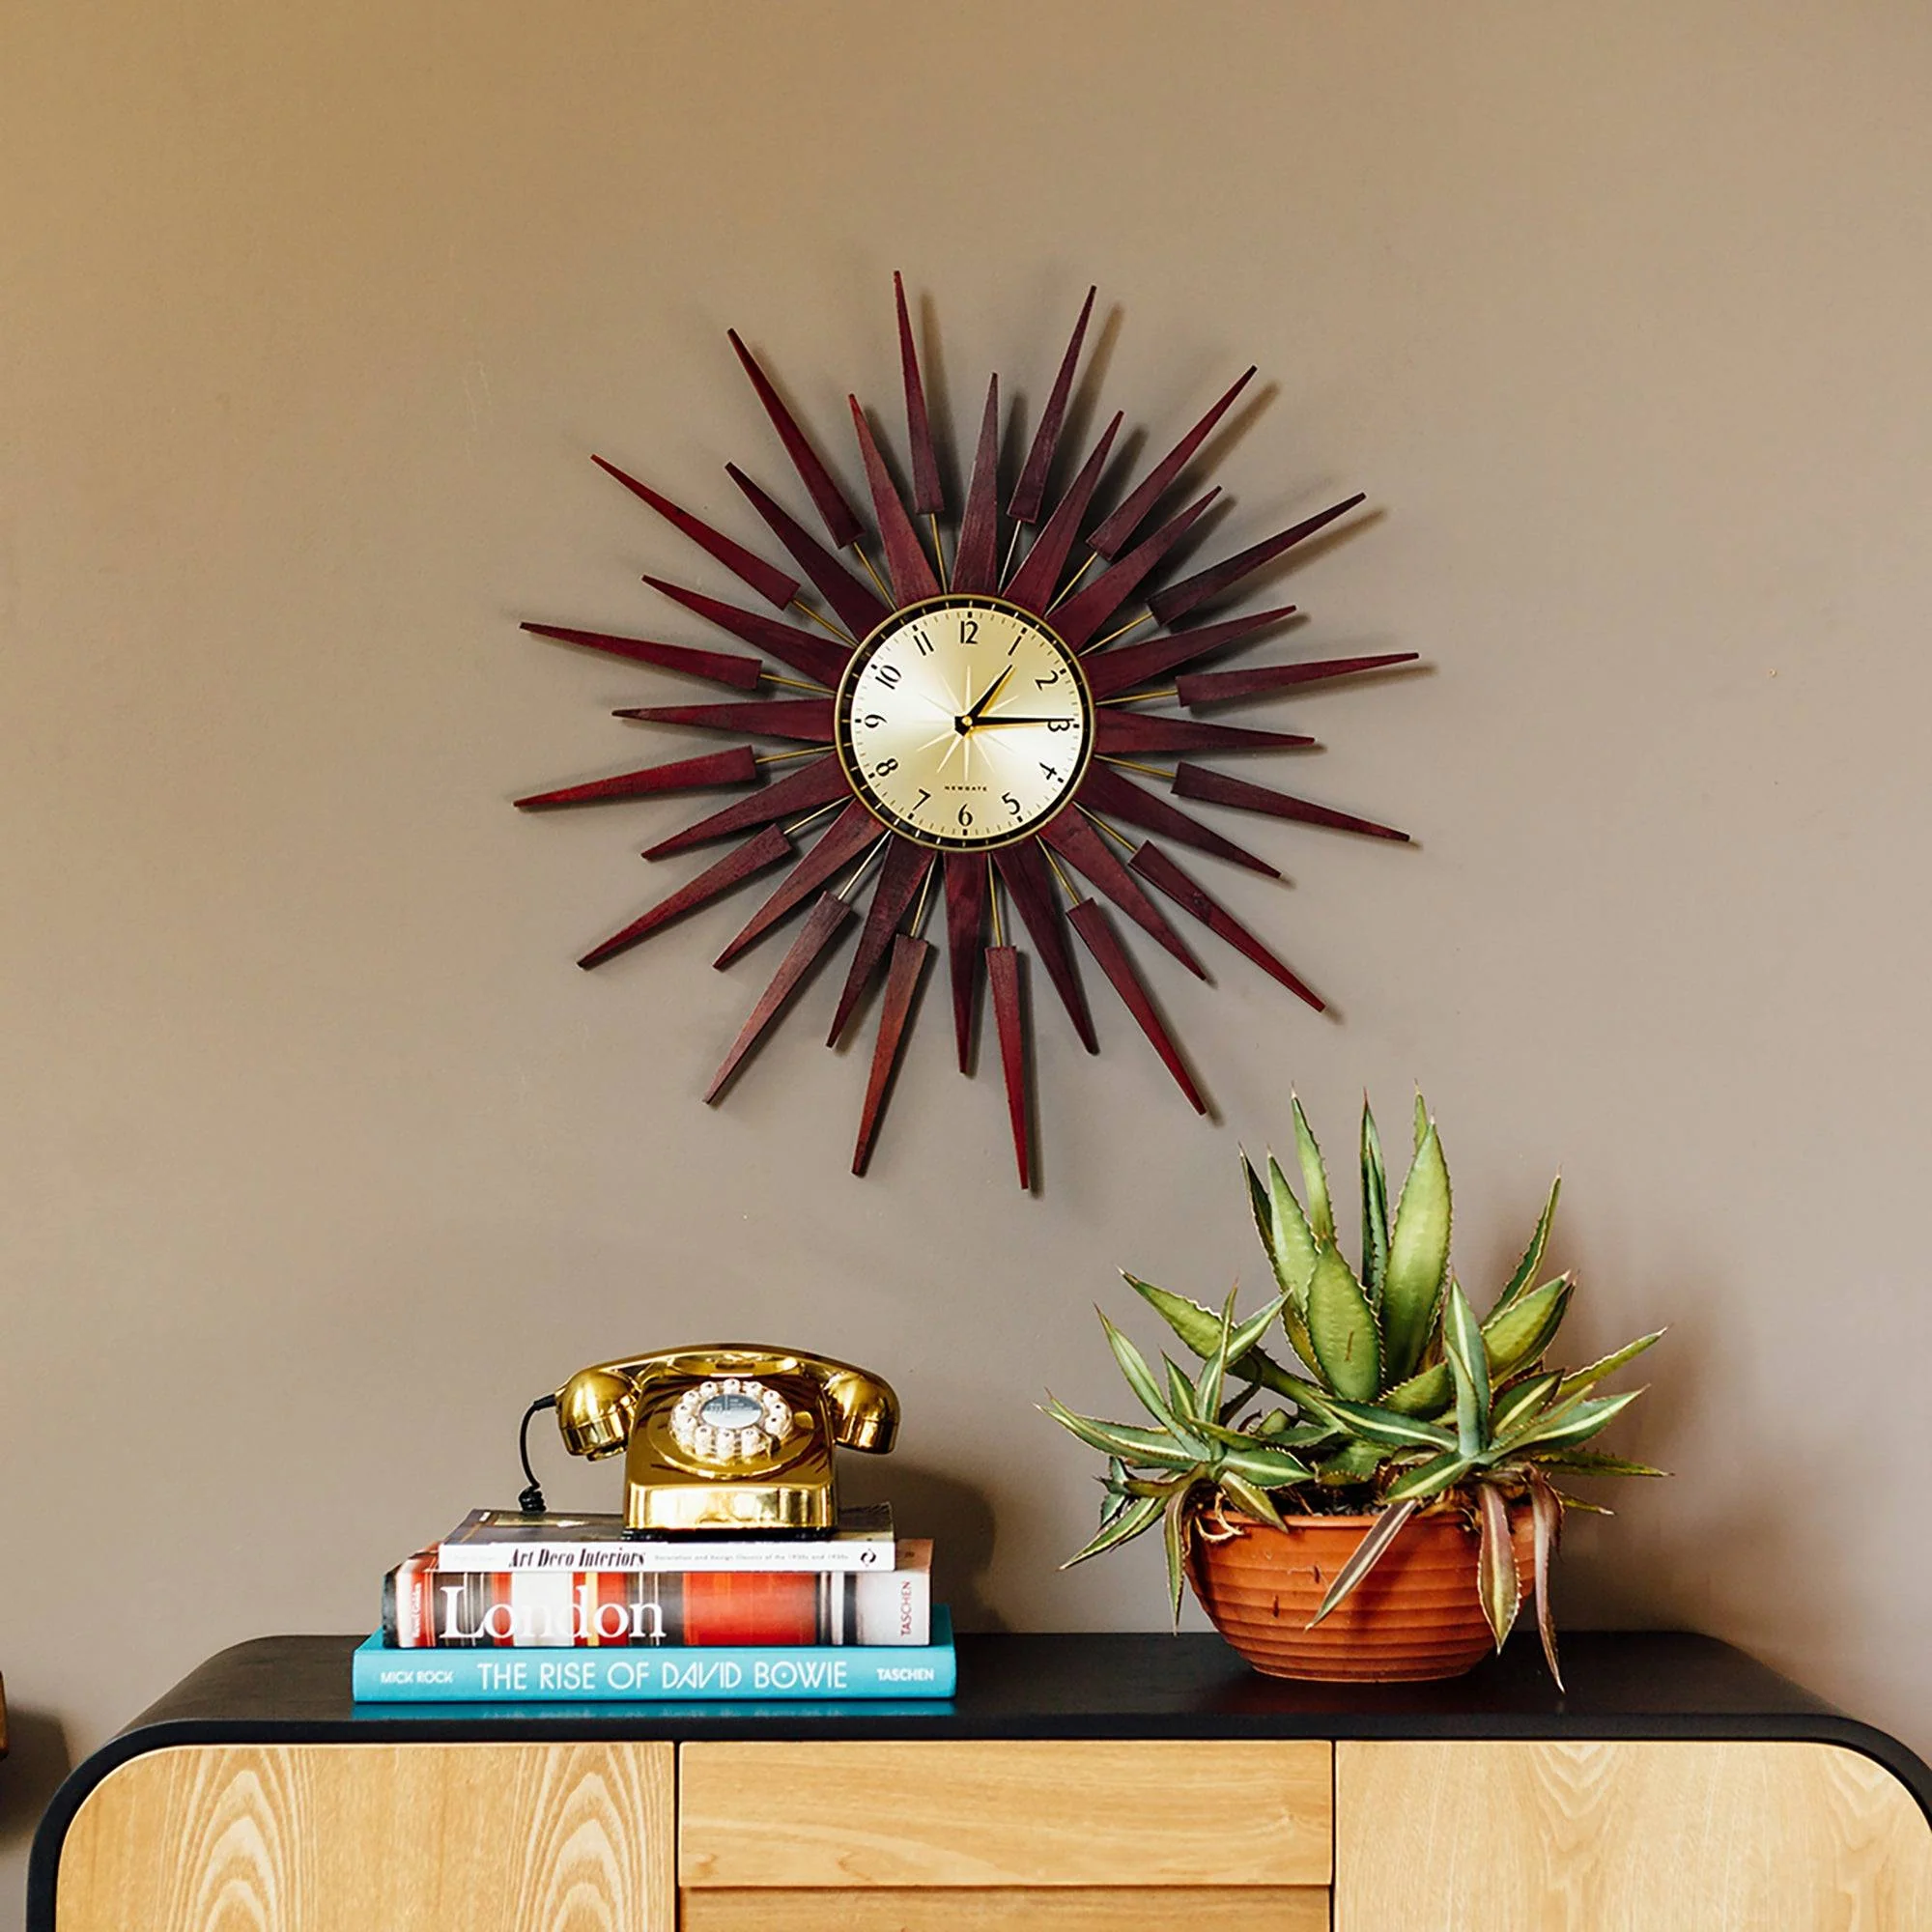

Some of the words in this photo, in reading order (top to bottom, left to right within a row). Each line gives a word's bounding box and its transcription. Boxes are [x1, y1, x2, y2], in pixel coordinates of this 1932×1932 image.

[959, 620, 979, 644] 12
[913, 631, 934, 656] 11
[1008, 636, 1022, 656] 1
[875, 665, 902, 690] 10
[1035, 670, 1059, 691] 2
[865, 714, 888, 728] 9
[1047, 717, 1070, 732] 3
[875, 757, 898, 777] 8
[1038, 762, 1057, 780] 4
[912, 789, 931, 810] 7
[1002, 792, 1021, 815] 5
[958, 804, 973, 826] 6
[508, 1548, 534, 1568] Art
[537, 1548, 574, 1567] Deco
[579, 1547, 646, 1568] Interiors
[440, 1584, 667, 1639] London
[900, 1580, 912, 1637] TASCHEN
[381, 1671, 413, 1685] MICK
[416, 1671, 454, 1685] ROCK
[477, 1662, 527, 1690] THE
[539, 1662, 596, 1690] RISE
[607, 1662, 649, 1690] OF
[662, 1662, 742, 1689] DAVID
[753, 1661, 847, 1689] BOWIE
[876, 1667, 934, 1682] TASCHEN
